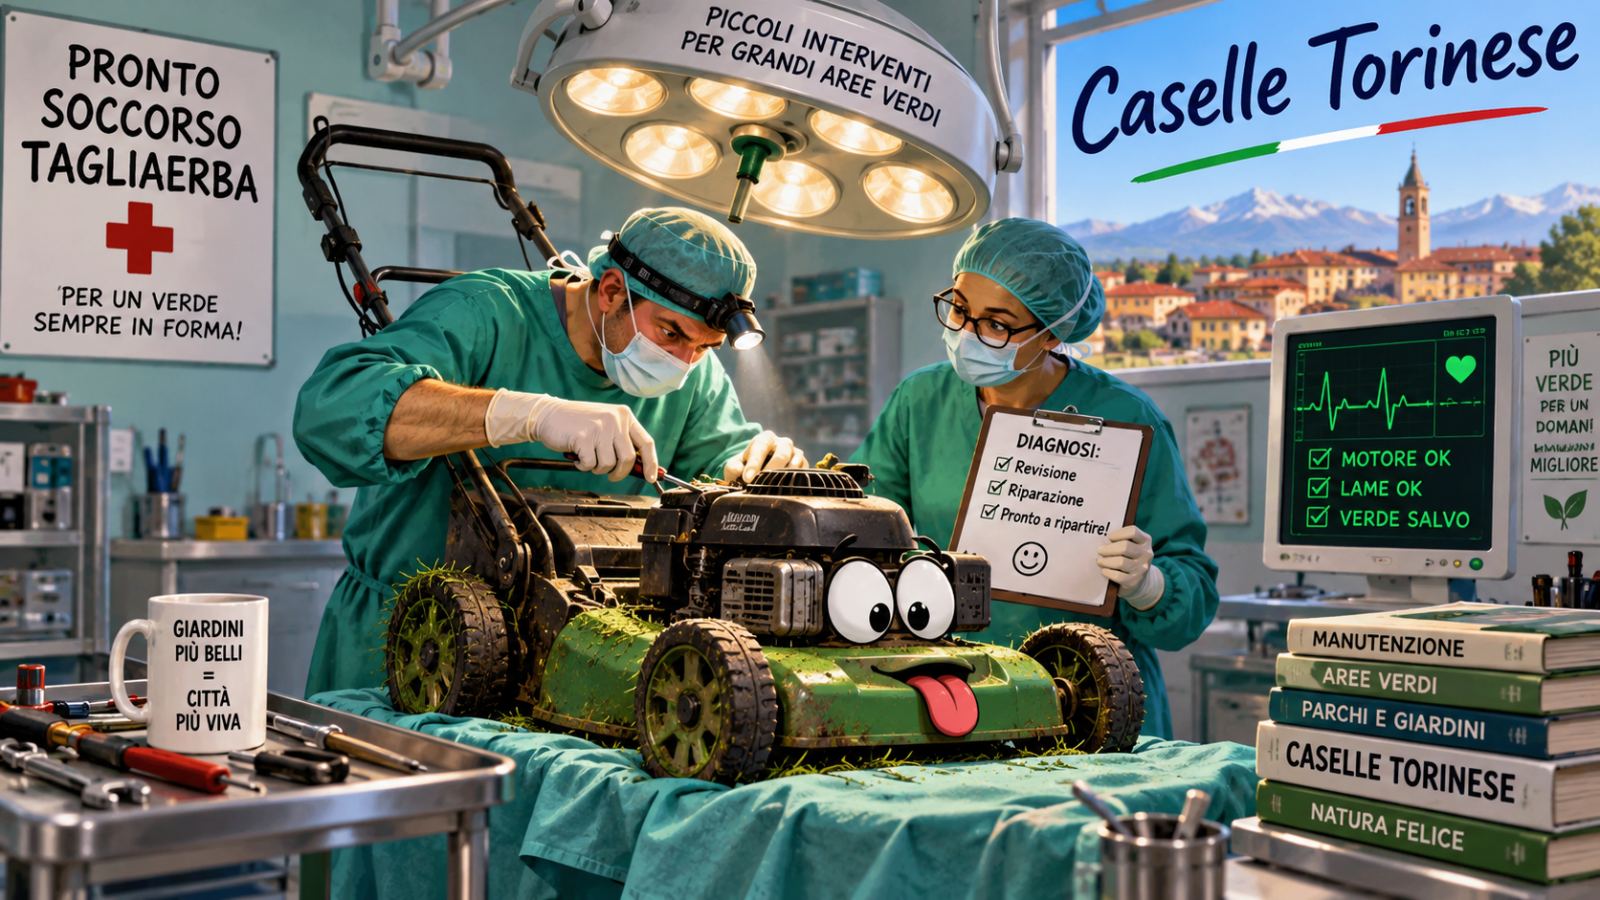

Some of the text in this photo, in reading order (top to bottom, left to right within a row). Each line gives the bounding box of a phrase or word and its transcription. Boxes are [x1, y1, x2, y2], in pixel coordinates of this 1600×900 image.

[706, 6, 932, 93] PICCOLI INTERVENTI
[69, 44, 220, 99] PRONTO
[681, 30, 941, 128] PER GRANDI AREE VERDI
[41, 88, 242, 149] SOCCORSO
[21, 141, 259, 204] TAGLIAERBA
[113, 289, 142, 309] UN
[152, 292, 219, 314] VERDE
[33, 312, 243, 341] SEMPRE IN FORMA!
[1549, 343, 1579, 368] PIÙ
[1535, 373, 1593, 392] VERDE
[1540, 398, 1589, 413] PER UN
[1016, 433, 1101, 459] DIAGNOSI:
[1341, 449, 1451, 468] MOTORE OK
[1014, 460, 1077, 482] Revisione
[1530, 456, 1598, 472] MIGLIORE
[1007, 483, 1084, 507] Riparazione
[1340, 480, 1422, 497] LAME OK
[1000, 507, 1111, 537] Pronto a ripartire!
[1339, 510, 1470, 529] VERDE SALVO
[173, 619, 244, 638] GIARDINI
[175, 641, 242, 662] PIÙ BELLI
[1312, 630, 1465, 658] MANUTENZIONE
[203, 671, 214, 680] =
[1322, 667, 1437, 695] AREE VERDI
[187, 686, 230, 707] CITTÀ
[176, 710, 241, 731] PIÙ VIVA
[1301, 700, 1368, 725] PARCHI
[1375, 709, 1387, 728] E
[1393, 711, 1486, 740] GIARDINI
[1285, 740, 1382, 782] CASELLE
[1389, 755, 1516, 804] TORINESE
[1310, 802, 1388, 836] NATURA
[1395, 818, 1465, 852] FELICE
